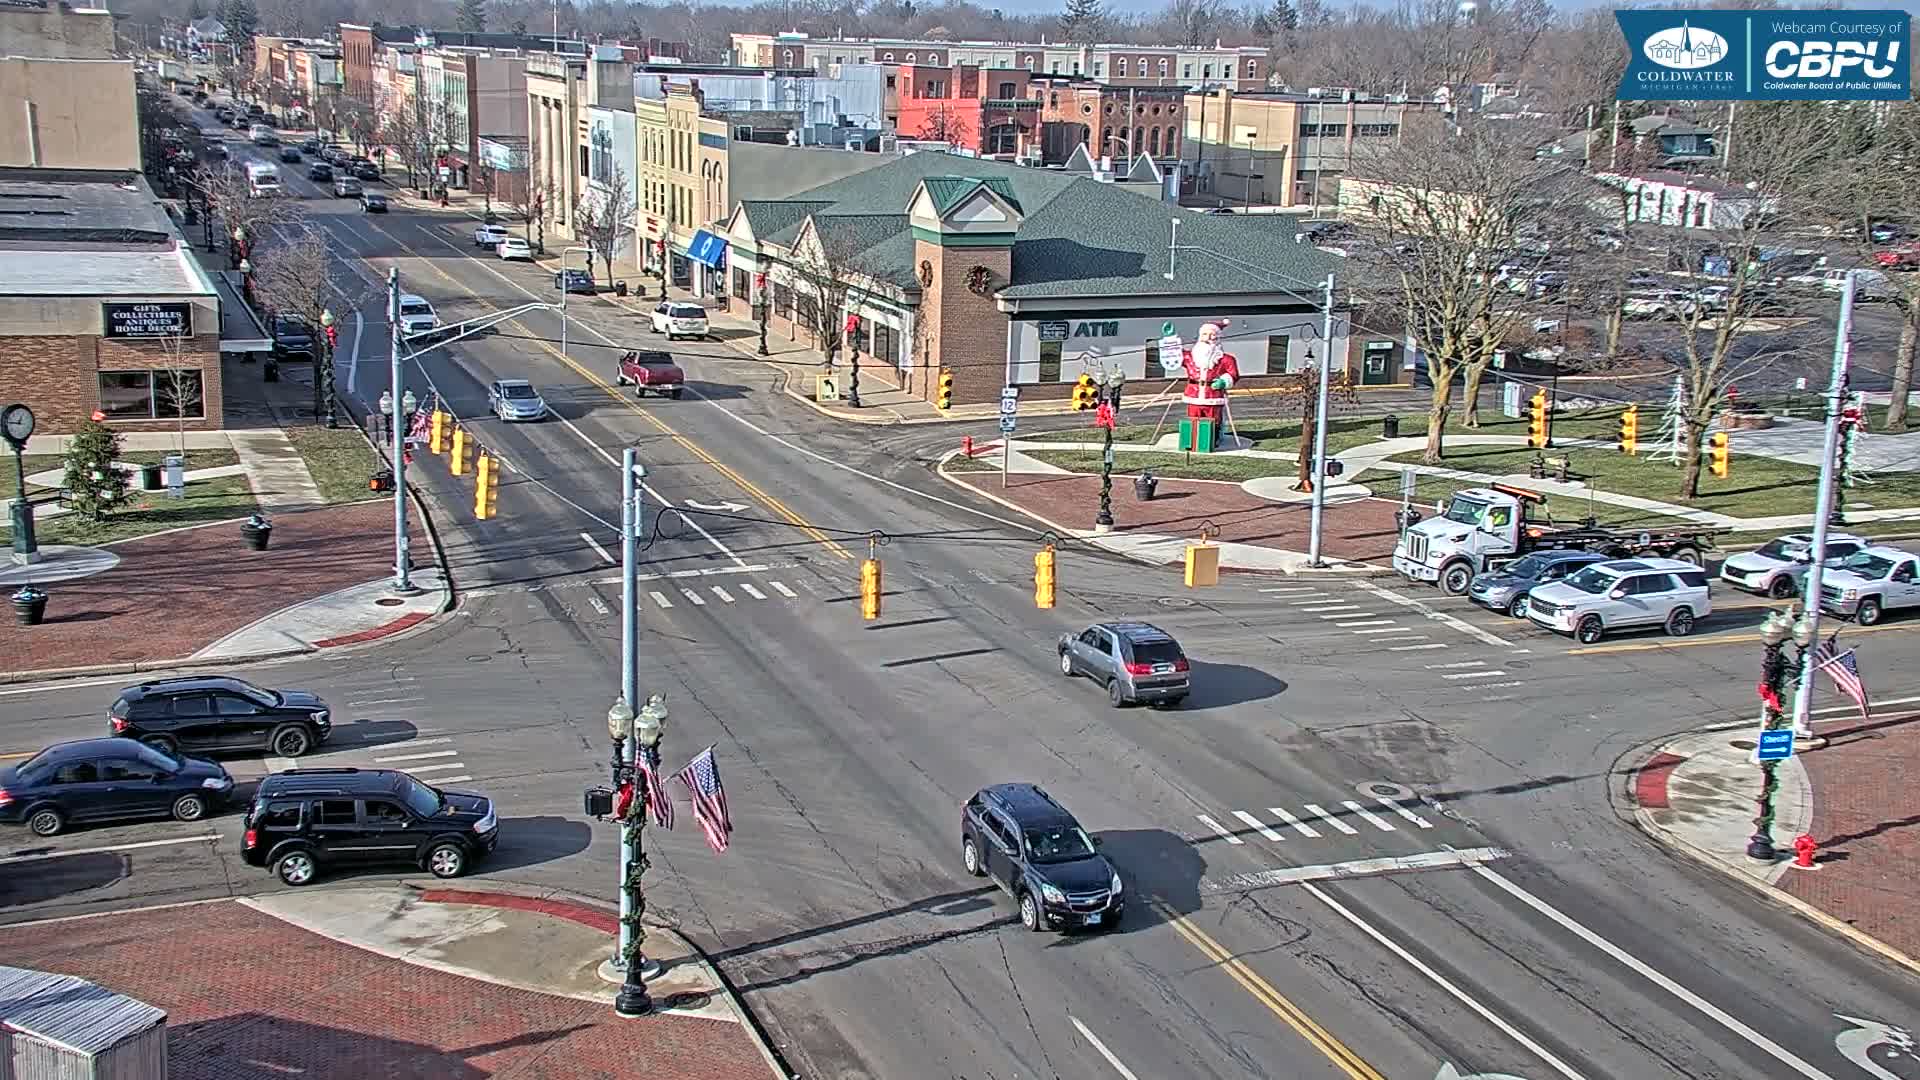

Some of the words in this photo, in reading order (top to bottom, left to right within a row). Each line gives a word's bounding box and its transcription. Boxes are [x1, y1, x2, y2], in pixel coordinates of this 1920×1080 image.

[112, 311, 182, 319] COLLECTIBLES
[115, 325, 145, 333] HOME
[1073, 321, 1119, 338] ATM
[1003, 401, 1014, 411] 12
